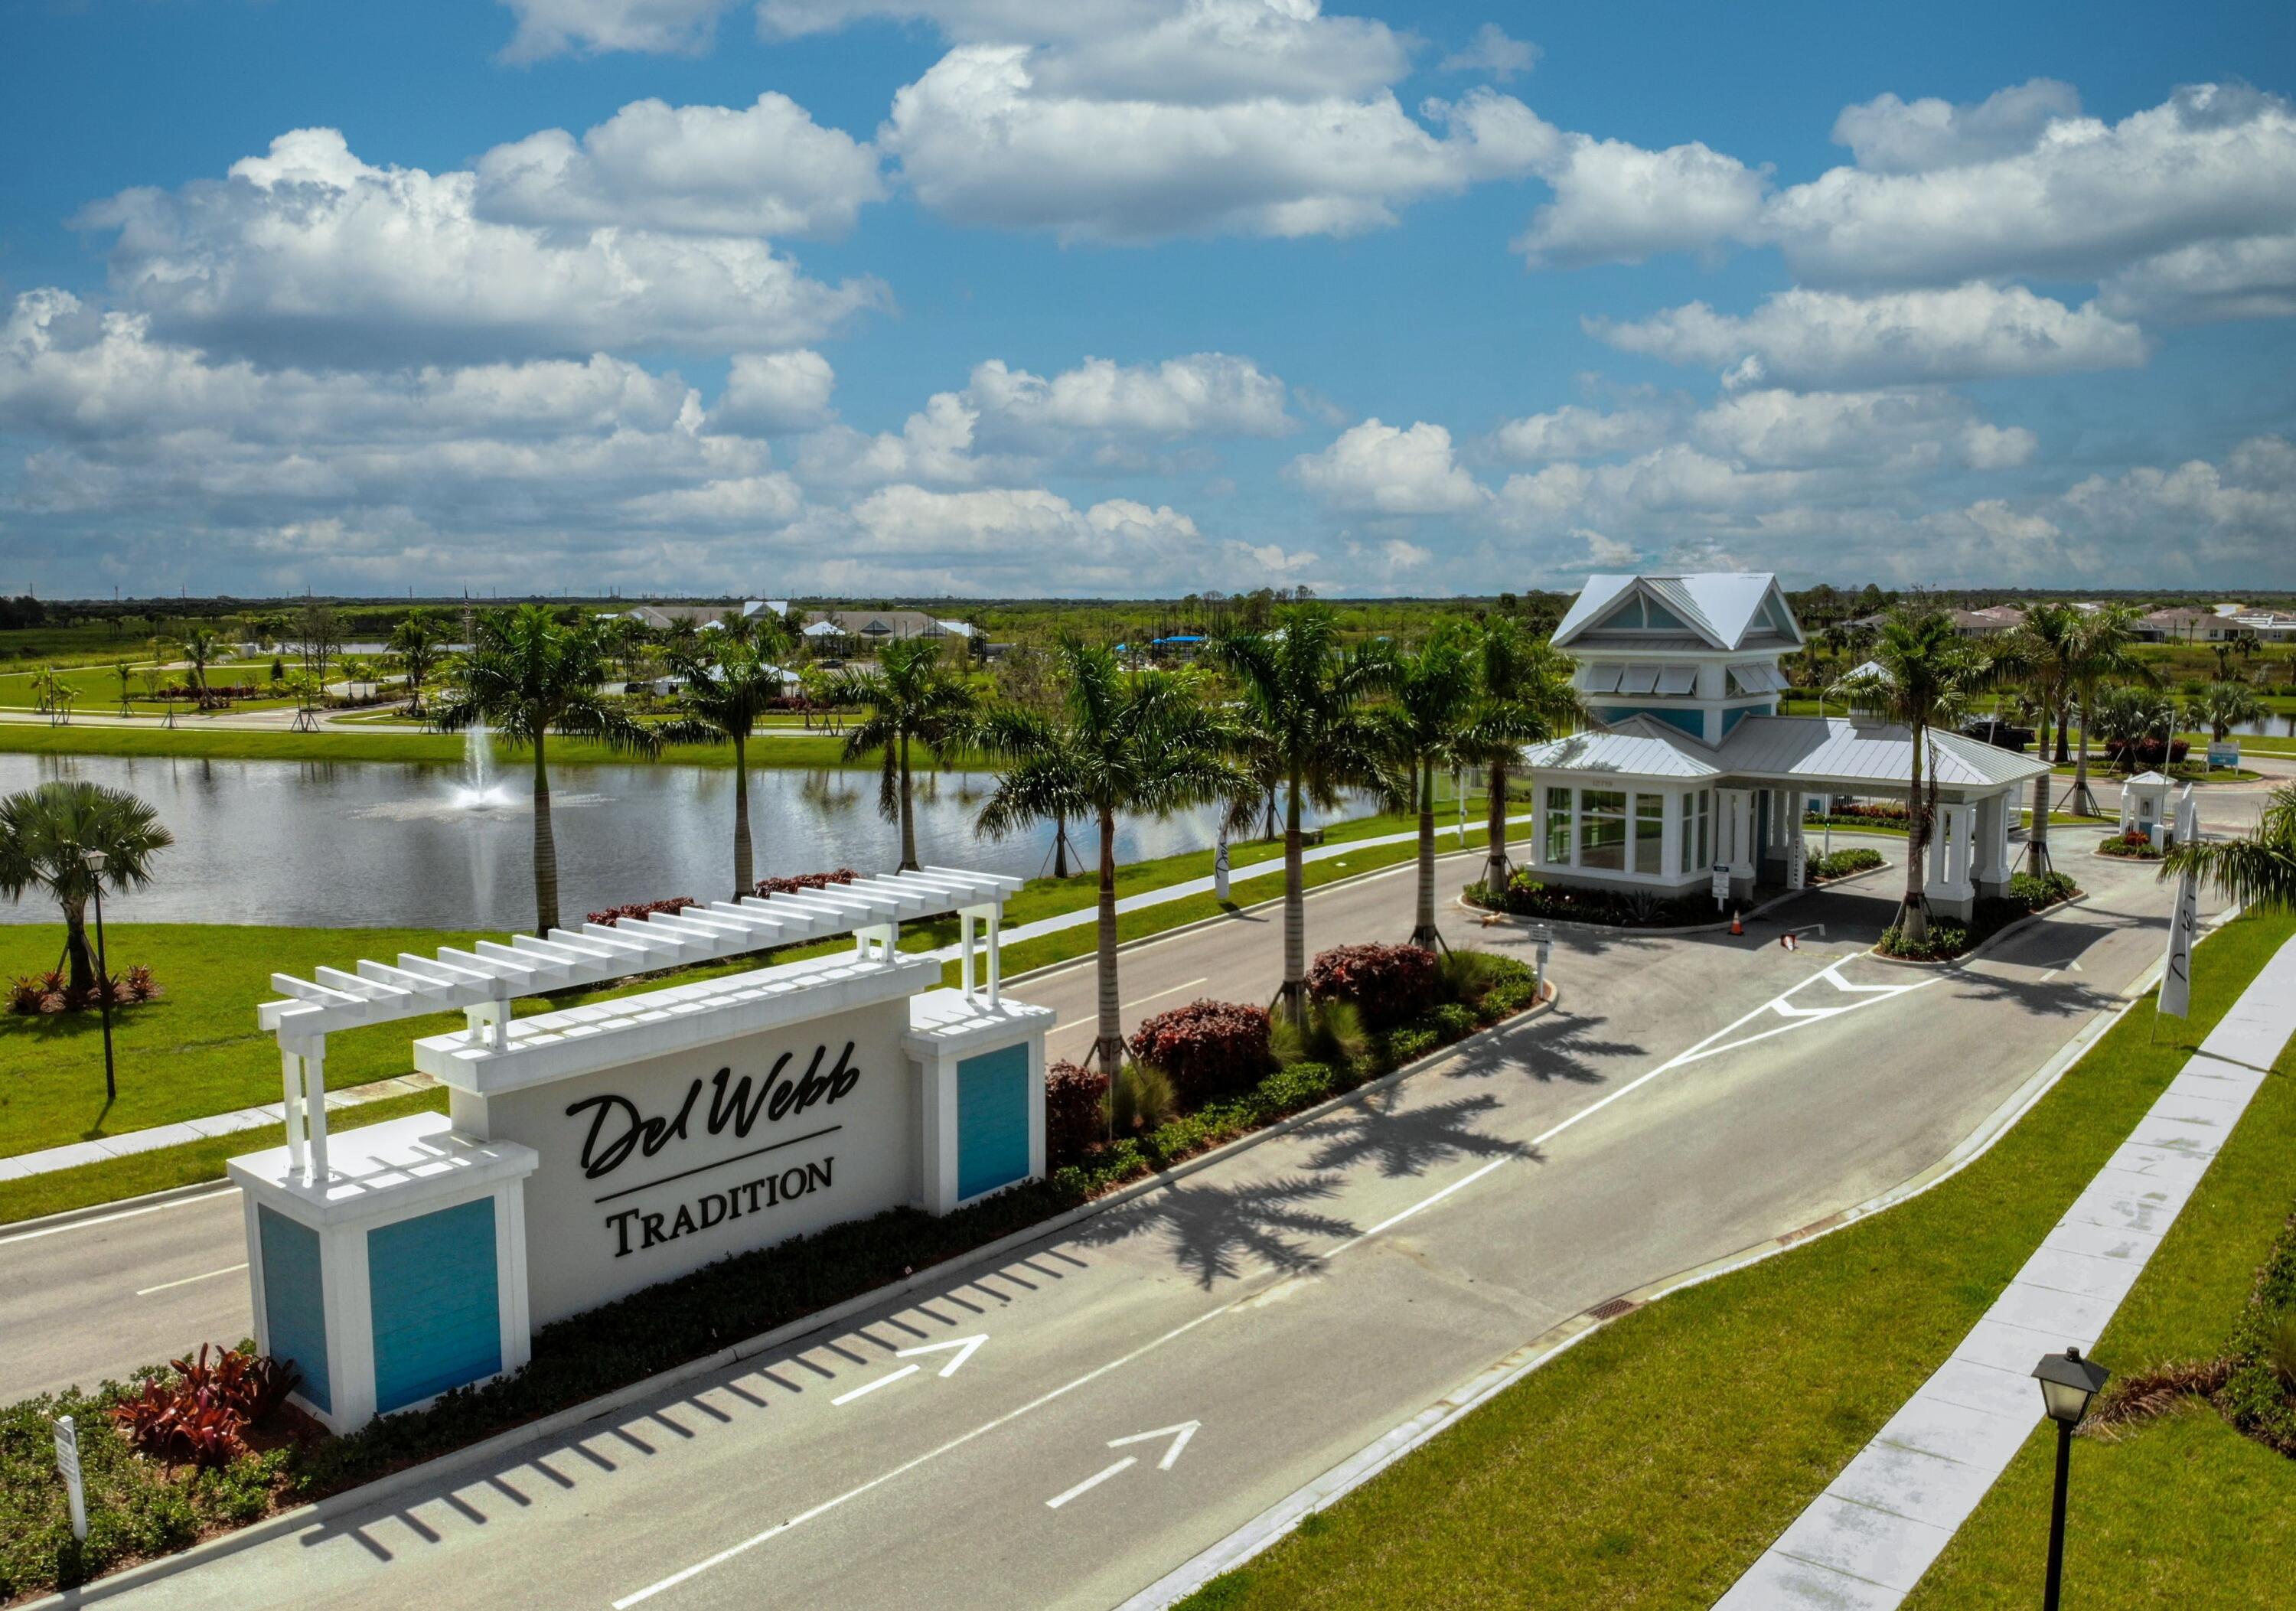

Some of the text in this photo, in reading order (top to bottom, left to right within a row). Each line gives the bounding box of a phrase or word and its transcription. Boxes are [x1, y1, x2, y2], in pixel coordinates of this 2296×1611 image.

[566, 1041, 860, 1179] Del Webb
[606, 1156, 834, 1257] TRADITION
